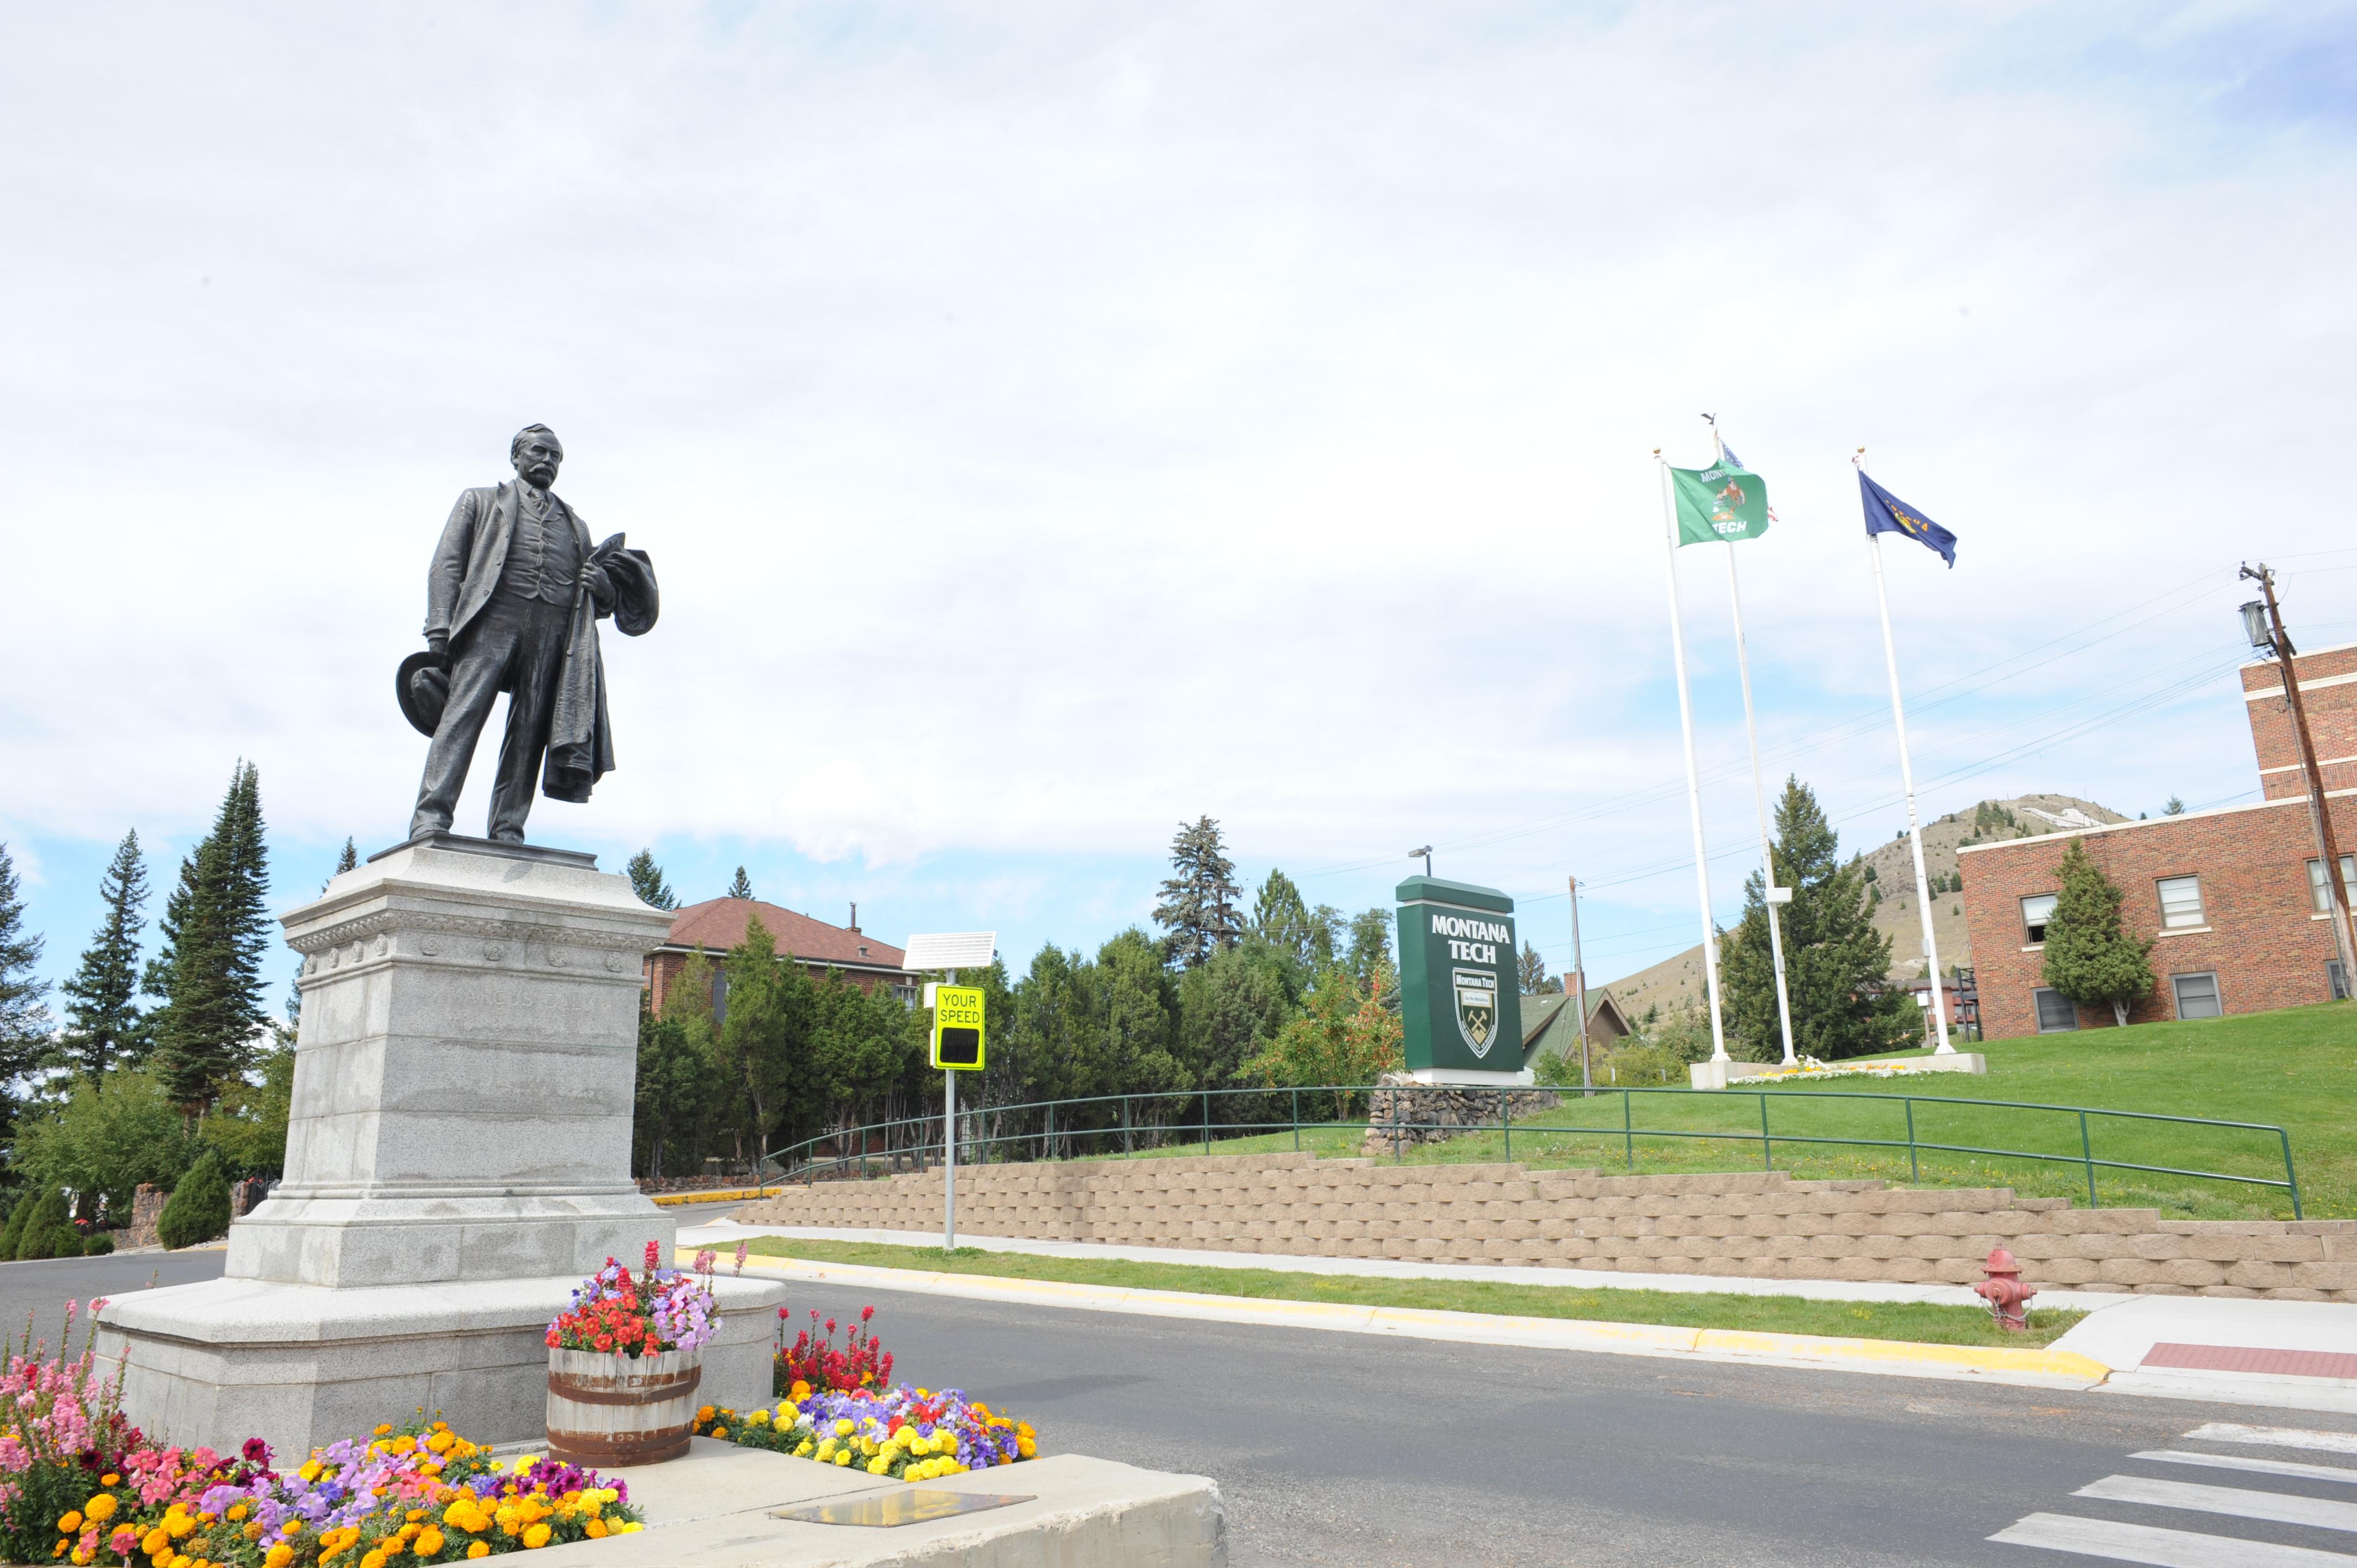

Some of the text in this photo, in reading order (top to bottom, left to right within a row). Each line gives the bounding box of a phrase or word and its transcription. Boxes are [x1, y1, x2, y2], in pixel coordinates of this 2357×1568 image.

[1712, 521, 1747, 534] TECH
[1432, 914, 1511, 944] MONTANA
[1448, 940, 1496, 964] TECH
[943, 993, 976, 1008] YOUR
[940, 1009, 980, 1023] SPEED
